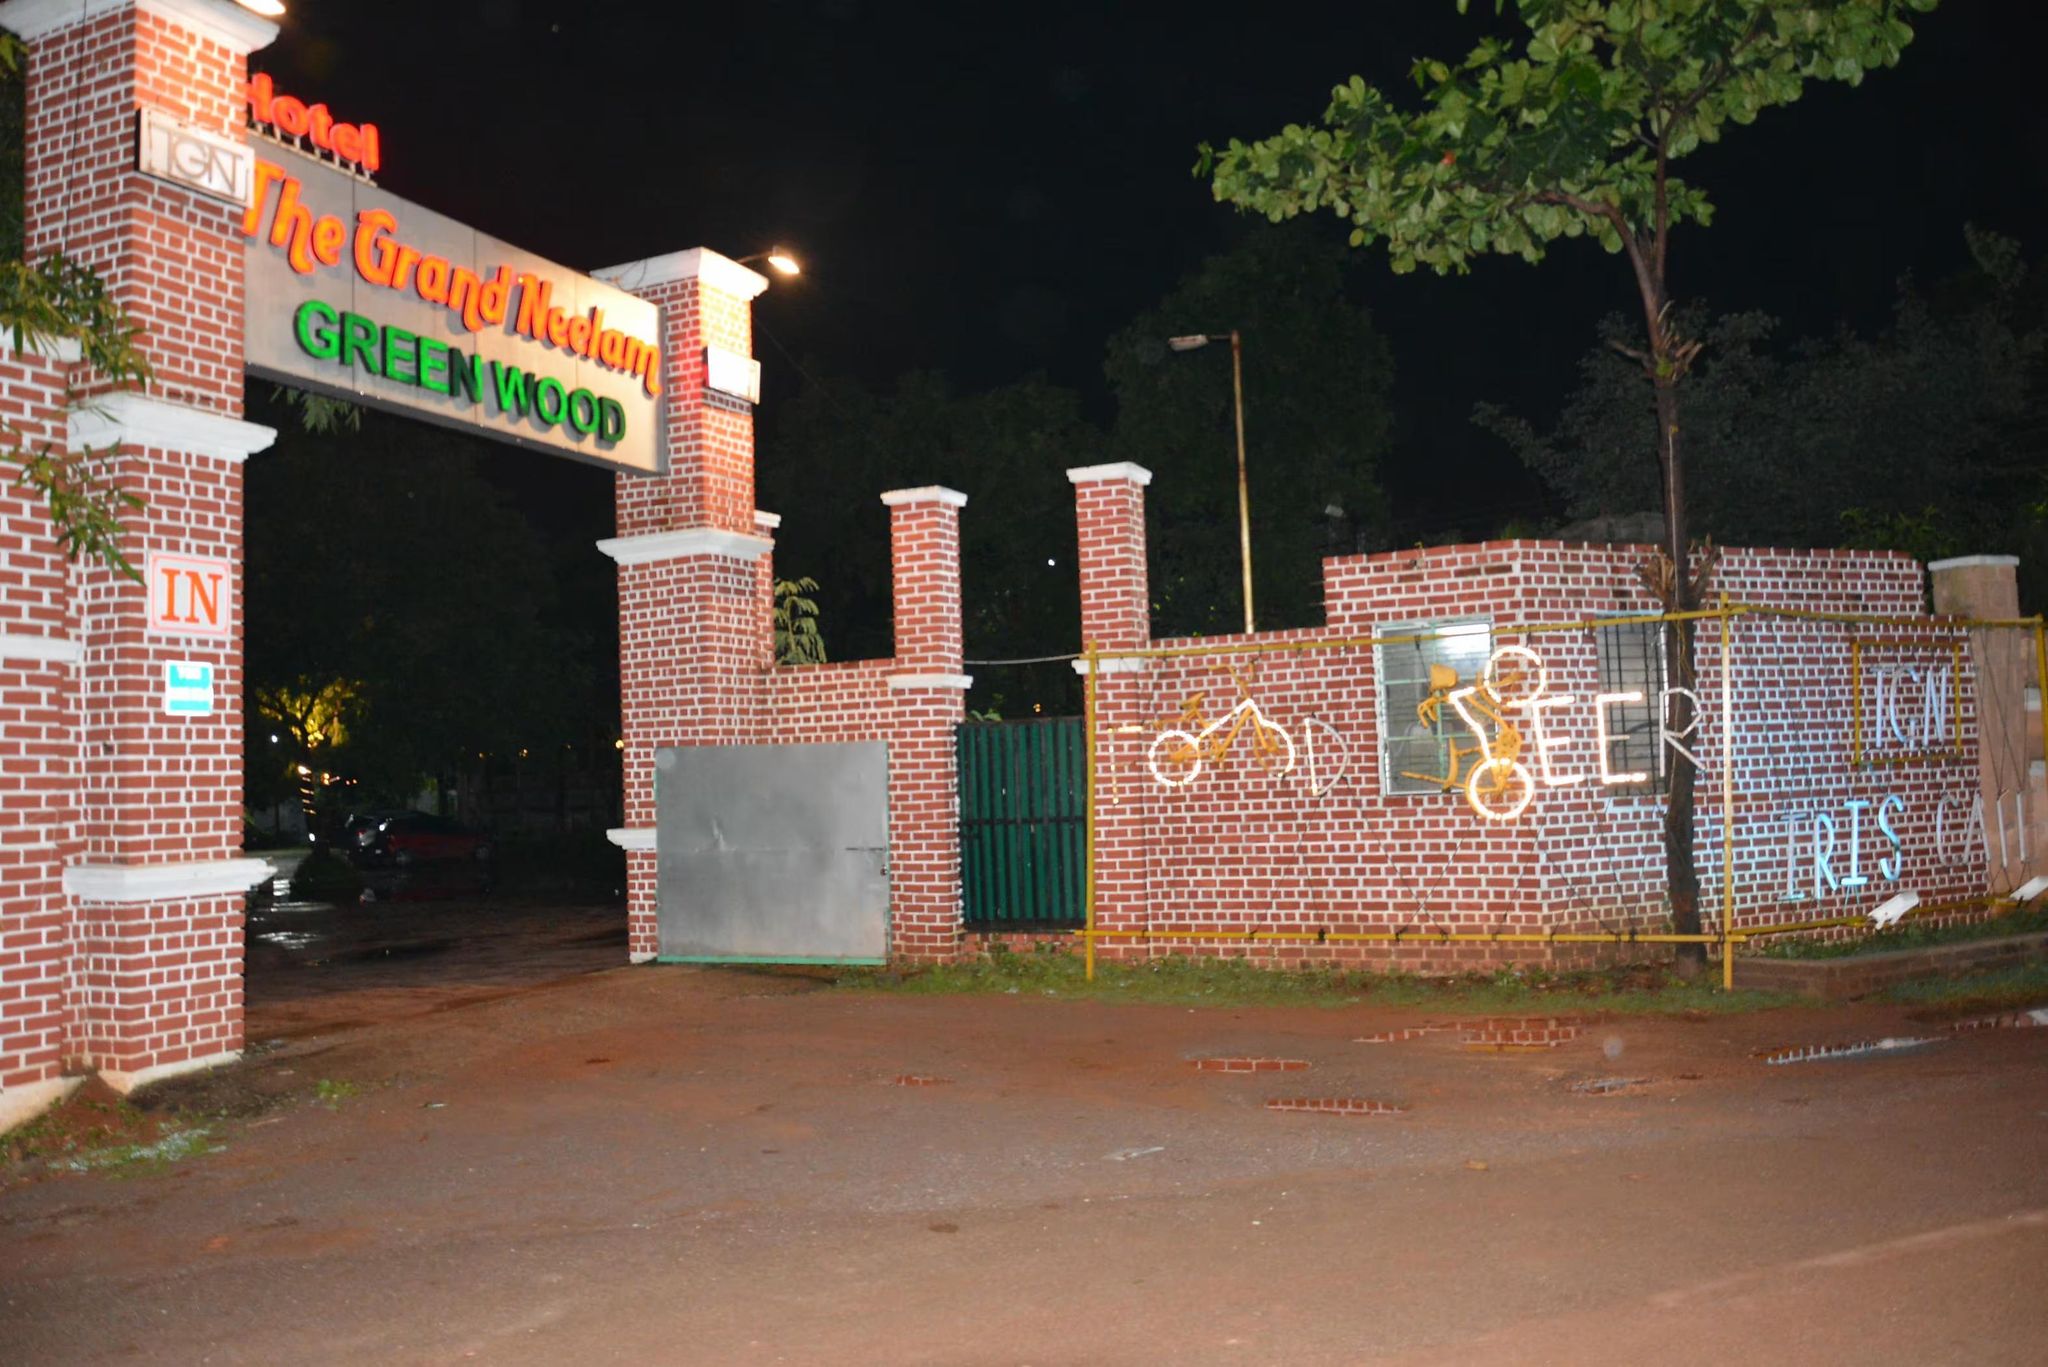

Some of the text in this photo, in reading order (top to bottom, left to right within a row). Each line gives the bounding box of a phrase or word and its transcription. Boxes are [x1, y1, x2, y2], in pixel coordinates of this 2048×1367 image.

[247, 72, 380, 170] Hotel
[242, 160, 662, 396] The Grand Neelam
[296, 300, 627, 443] GREEN WOOD
[160, 568, 223, 625] IN
[1777, 793, 1904, 901] IRIS
